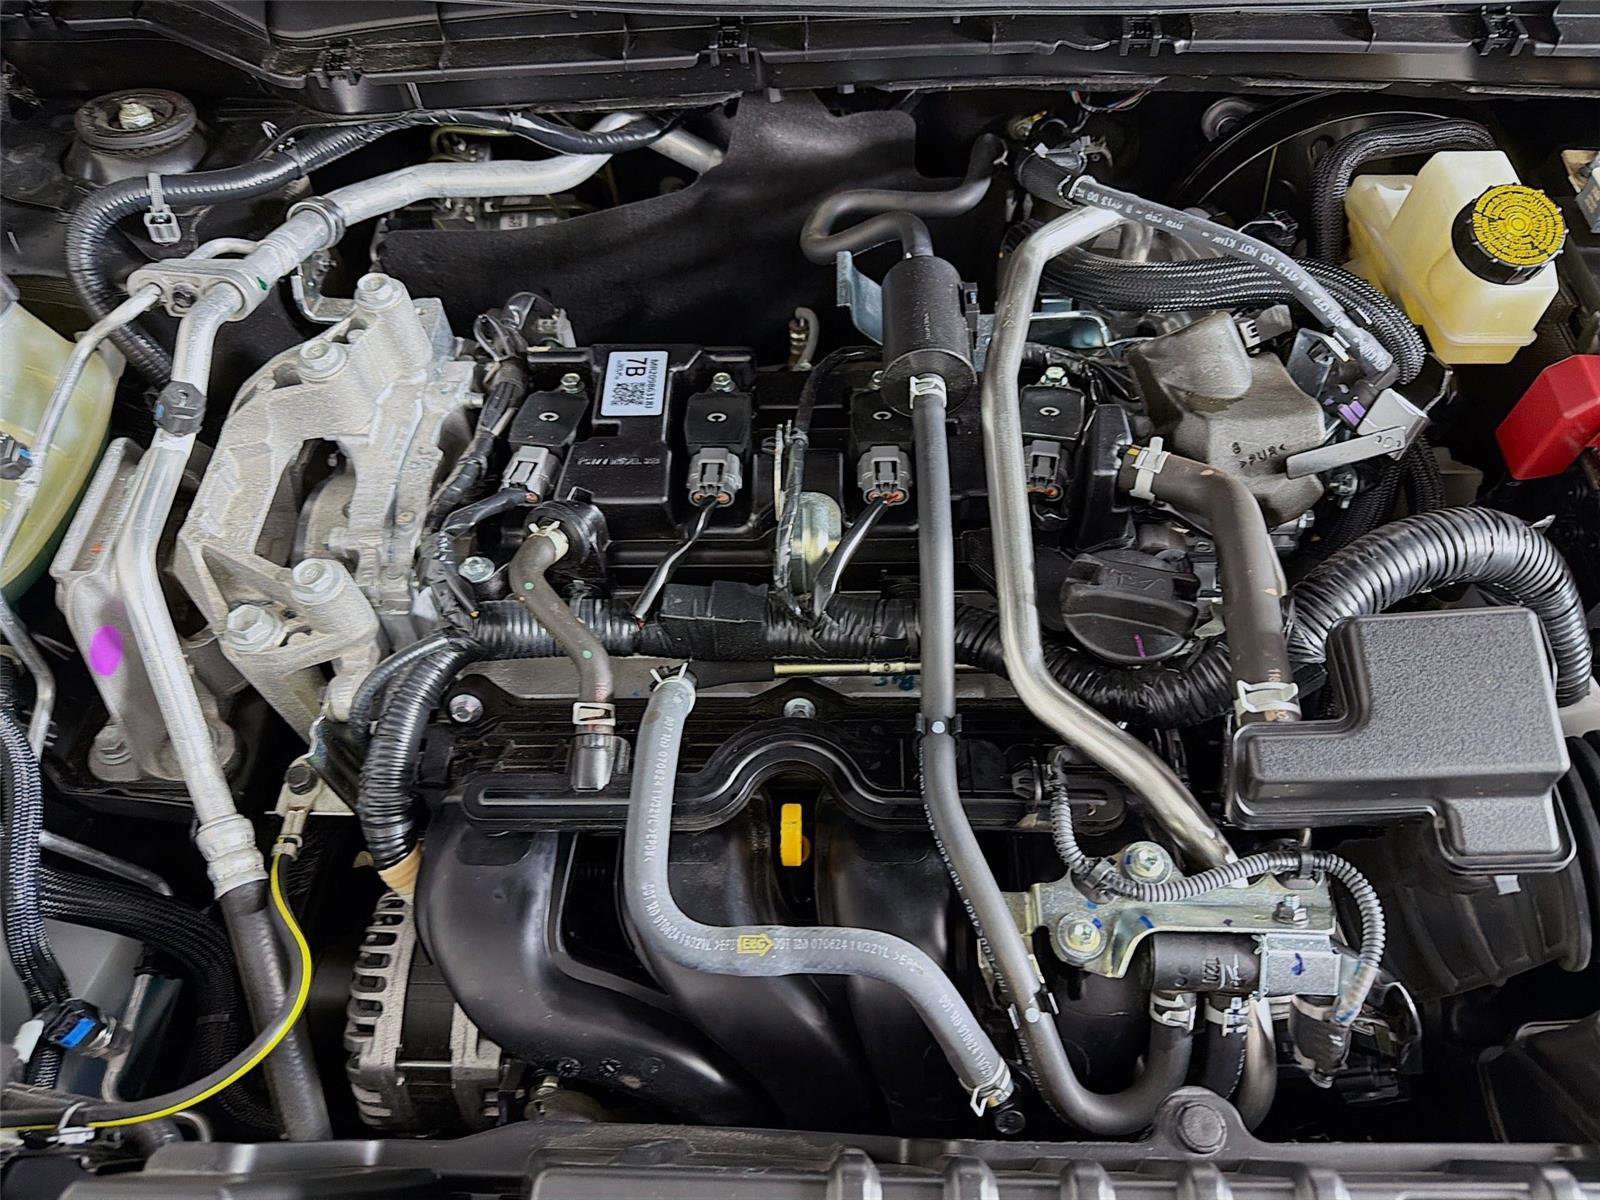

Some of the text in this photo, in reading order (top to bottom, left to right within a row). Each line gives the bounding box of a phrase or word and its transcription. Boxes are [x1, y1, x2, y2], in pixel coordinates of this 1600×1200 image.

[1238, 244, 1258, 255] NOT
[1260, 253, 1275, 265] DO
[626, 358, 648, 376] 7B
